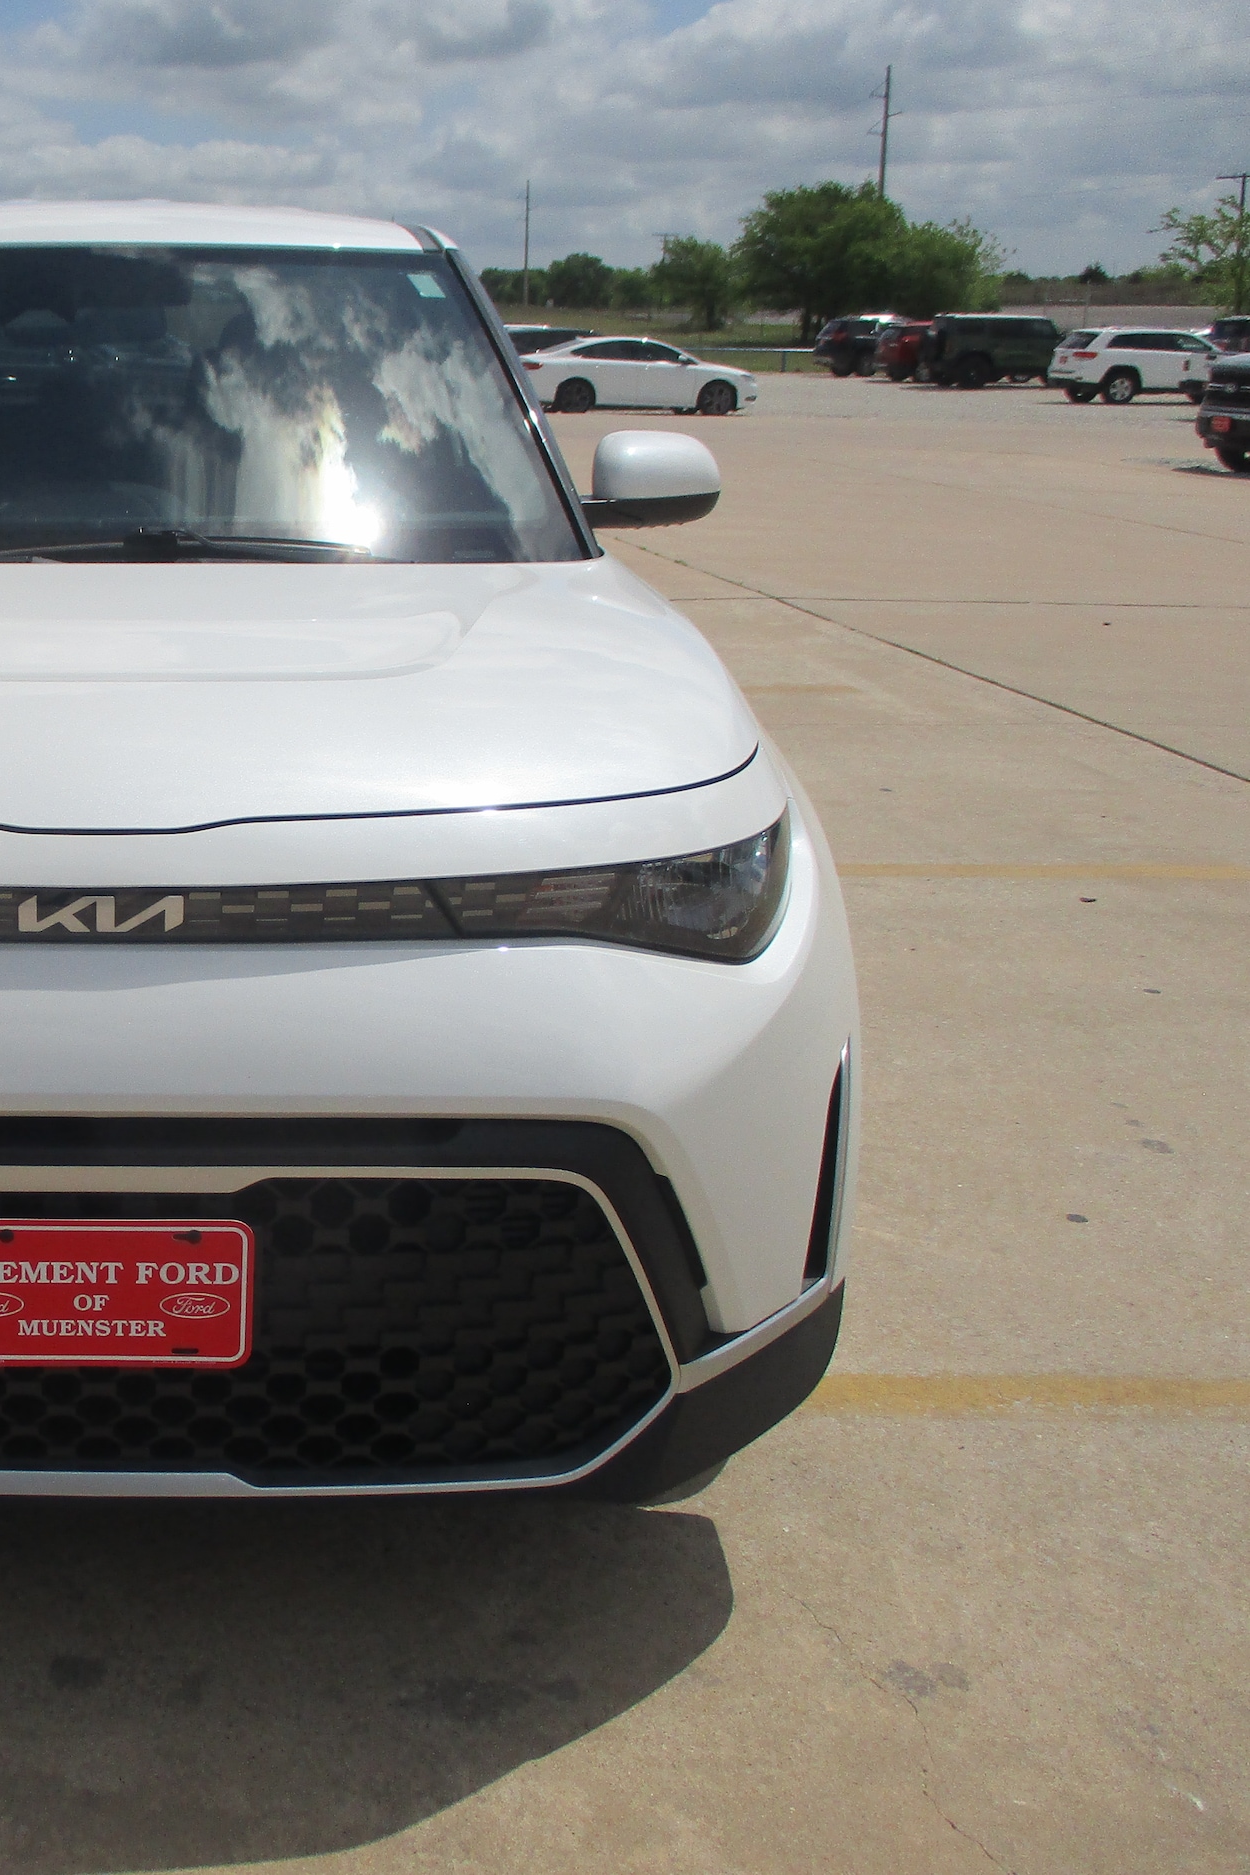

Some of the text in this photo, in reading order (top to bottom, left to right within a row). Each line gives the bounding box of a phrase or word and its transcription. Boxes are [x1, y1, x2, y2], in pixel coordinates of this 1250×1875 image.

[18, 895, 184, 932] KIA
[135, 1262, 240, 1285] FORD
[73, 1294, 110, 1312] OF
[172, 1296, 216, 1314] Ford
[17, 1319, 167, 1337] MUENSTER
